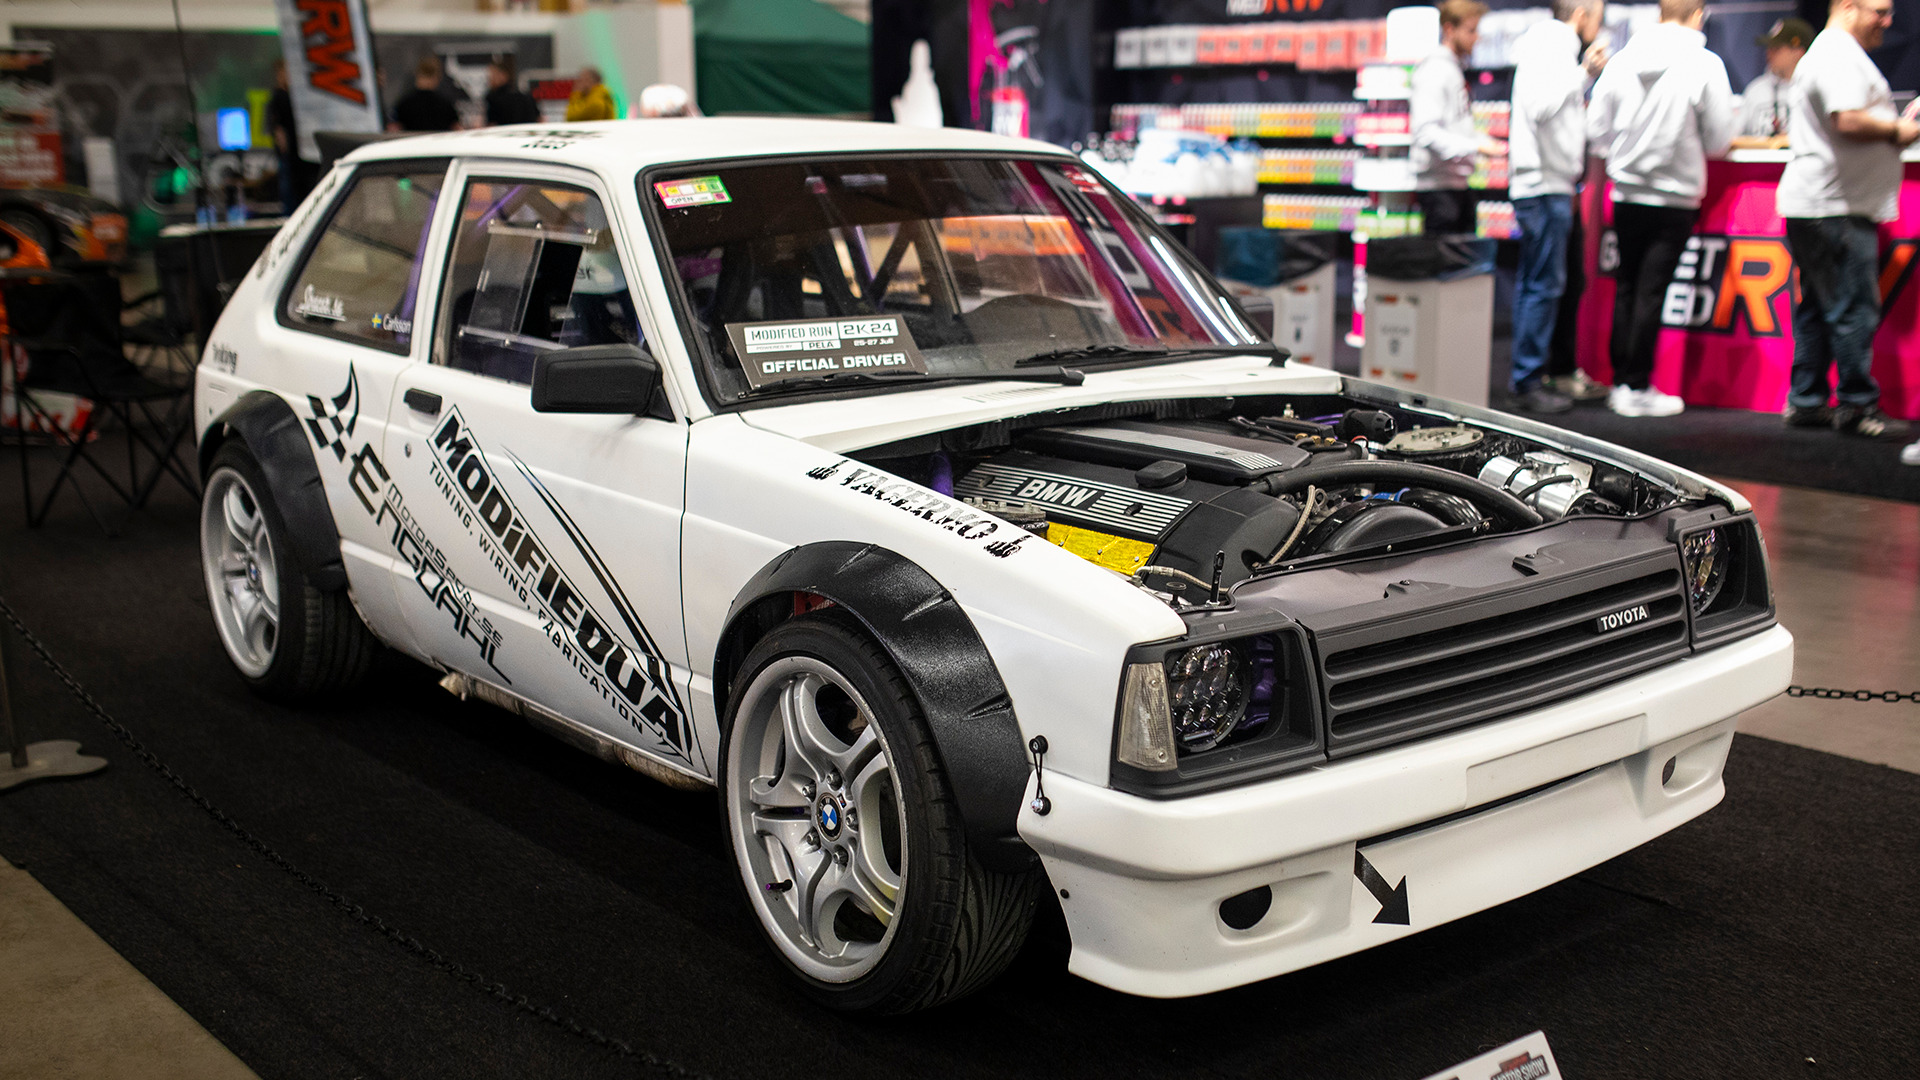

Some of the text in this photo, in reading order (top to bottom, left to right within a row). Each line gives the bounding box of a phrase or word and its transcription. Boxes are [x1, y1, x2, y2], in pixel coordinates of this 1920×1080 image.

[751, 325, 833, 341] MODIFIED RUN
[843, 322, 892, 335] 2K24
[809, 341, 834, 349] PELA
[762, 352, 906, 374] OFFICIAL DRIVER
[1017, 479, 1098, 508] BMW
[428, 460, 643, 735] TUNING, WIRING, FABRICATION
[1600, 605, 1648, 631] TOYOTA
